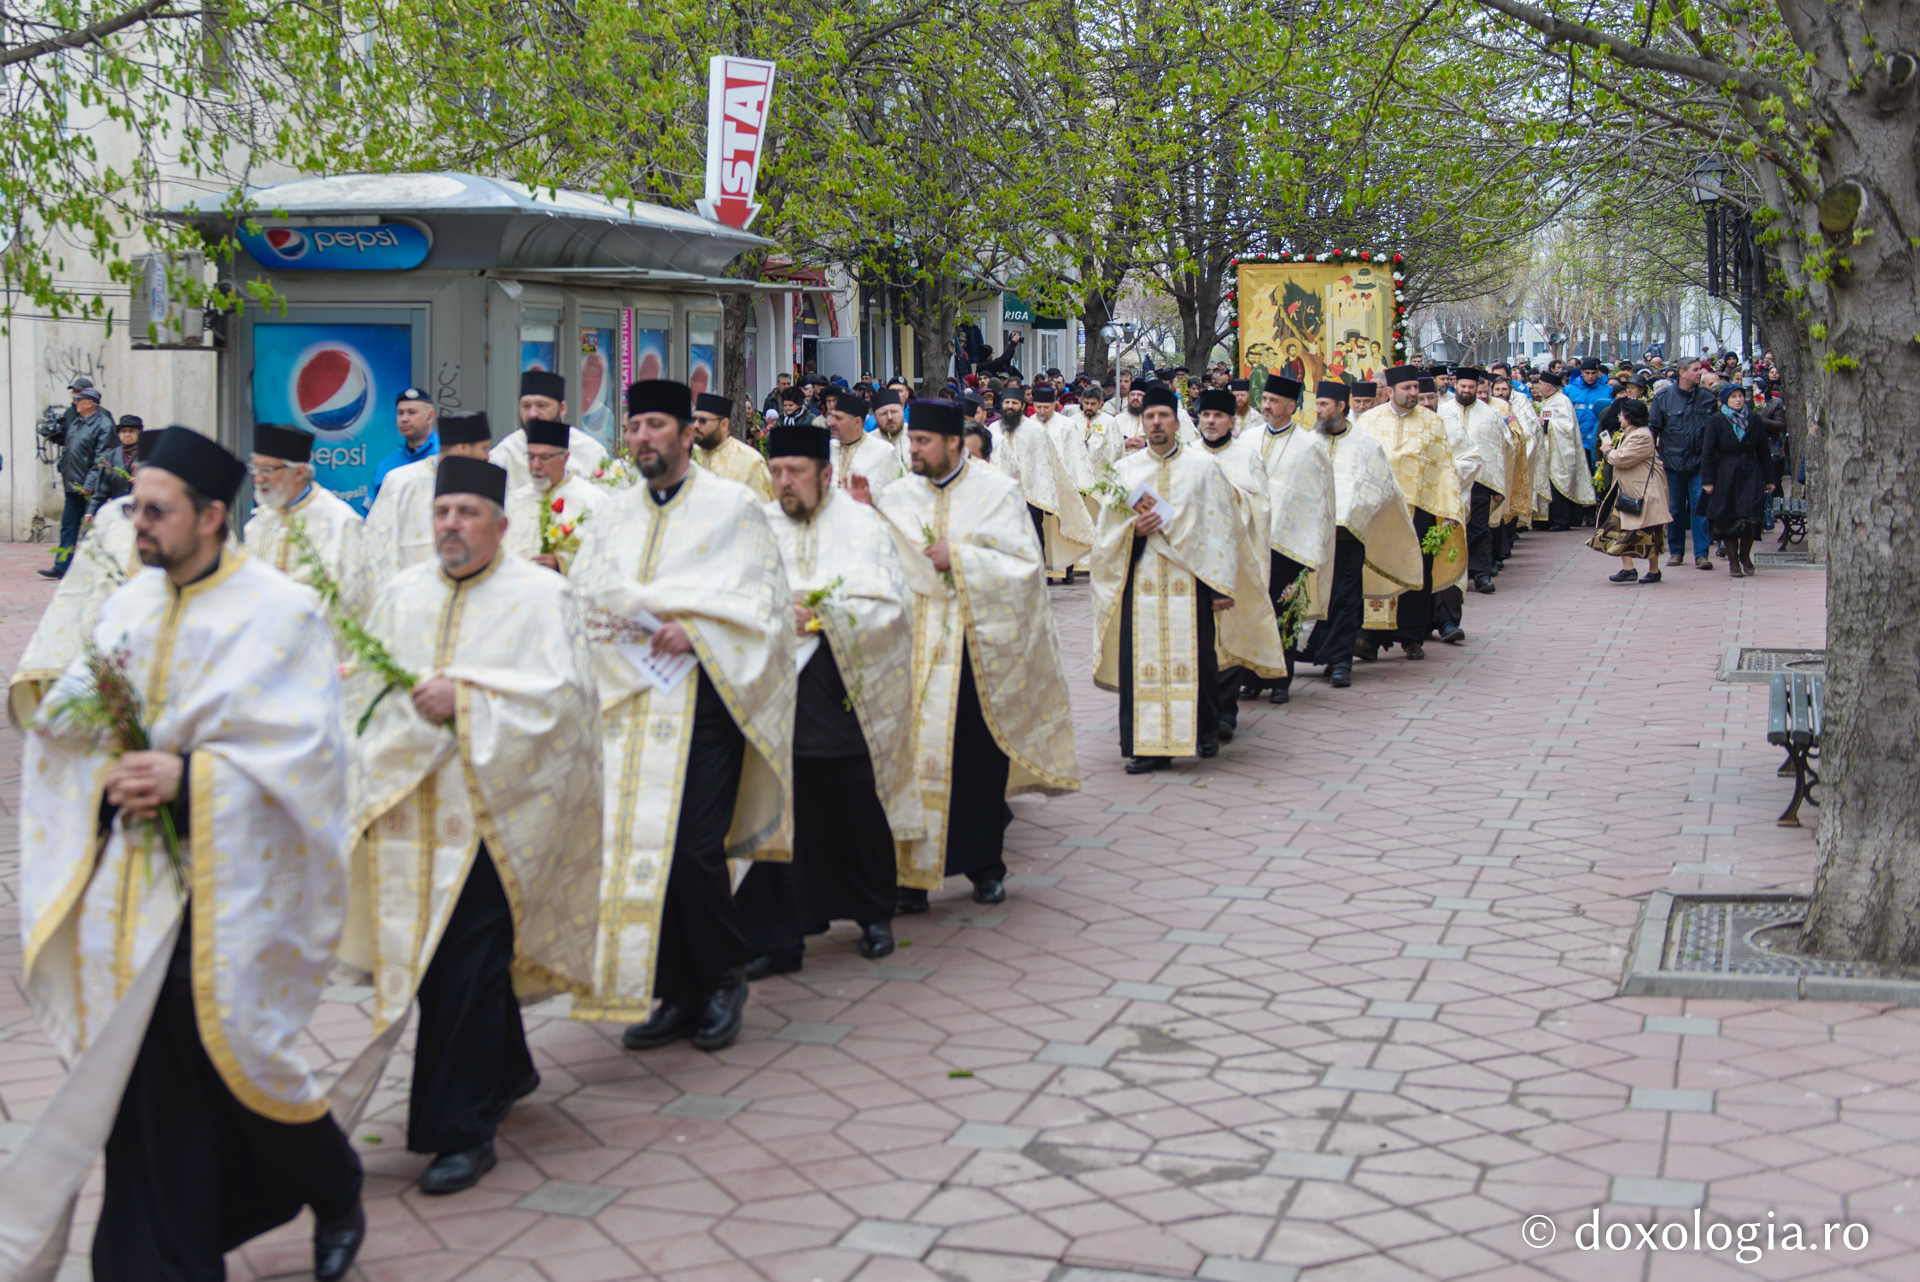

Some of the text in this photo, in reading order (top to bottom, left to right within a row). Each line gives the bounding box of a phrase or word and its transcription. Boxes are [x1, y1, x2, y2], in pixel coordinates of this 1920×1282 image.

[722, 61, 769, 195] STAI
[313, 229, 399, 252] pepsi
[1004, 310, 1029, 321] RIGA
[310, 443, 367, 470] epsi
